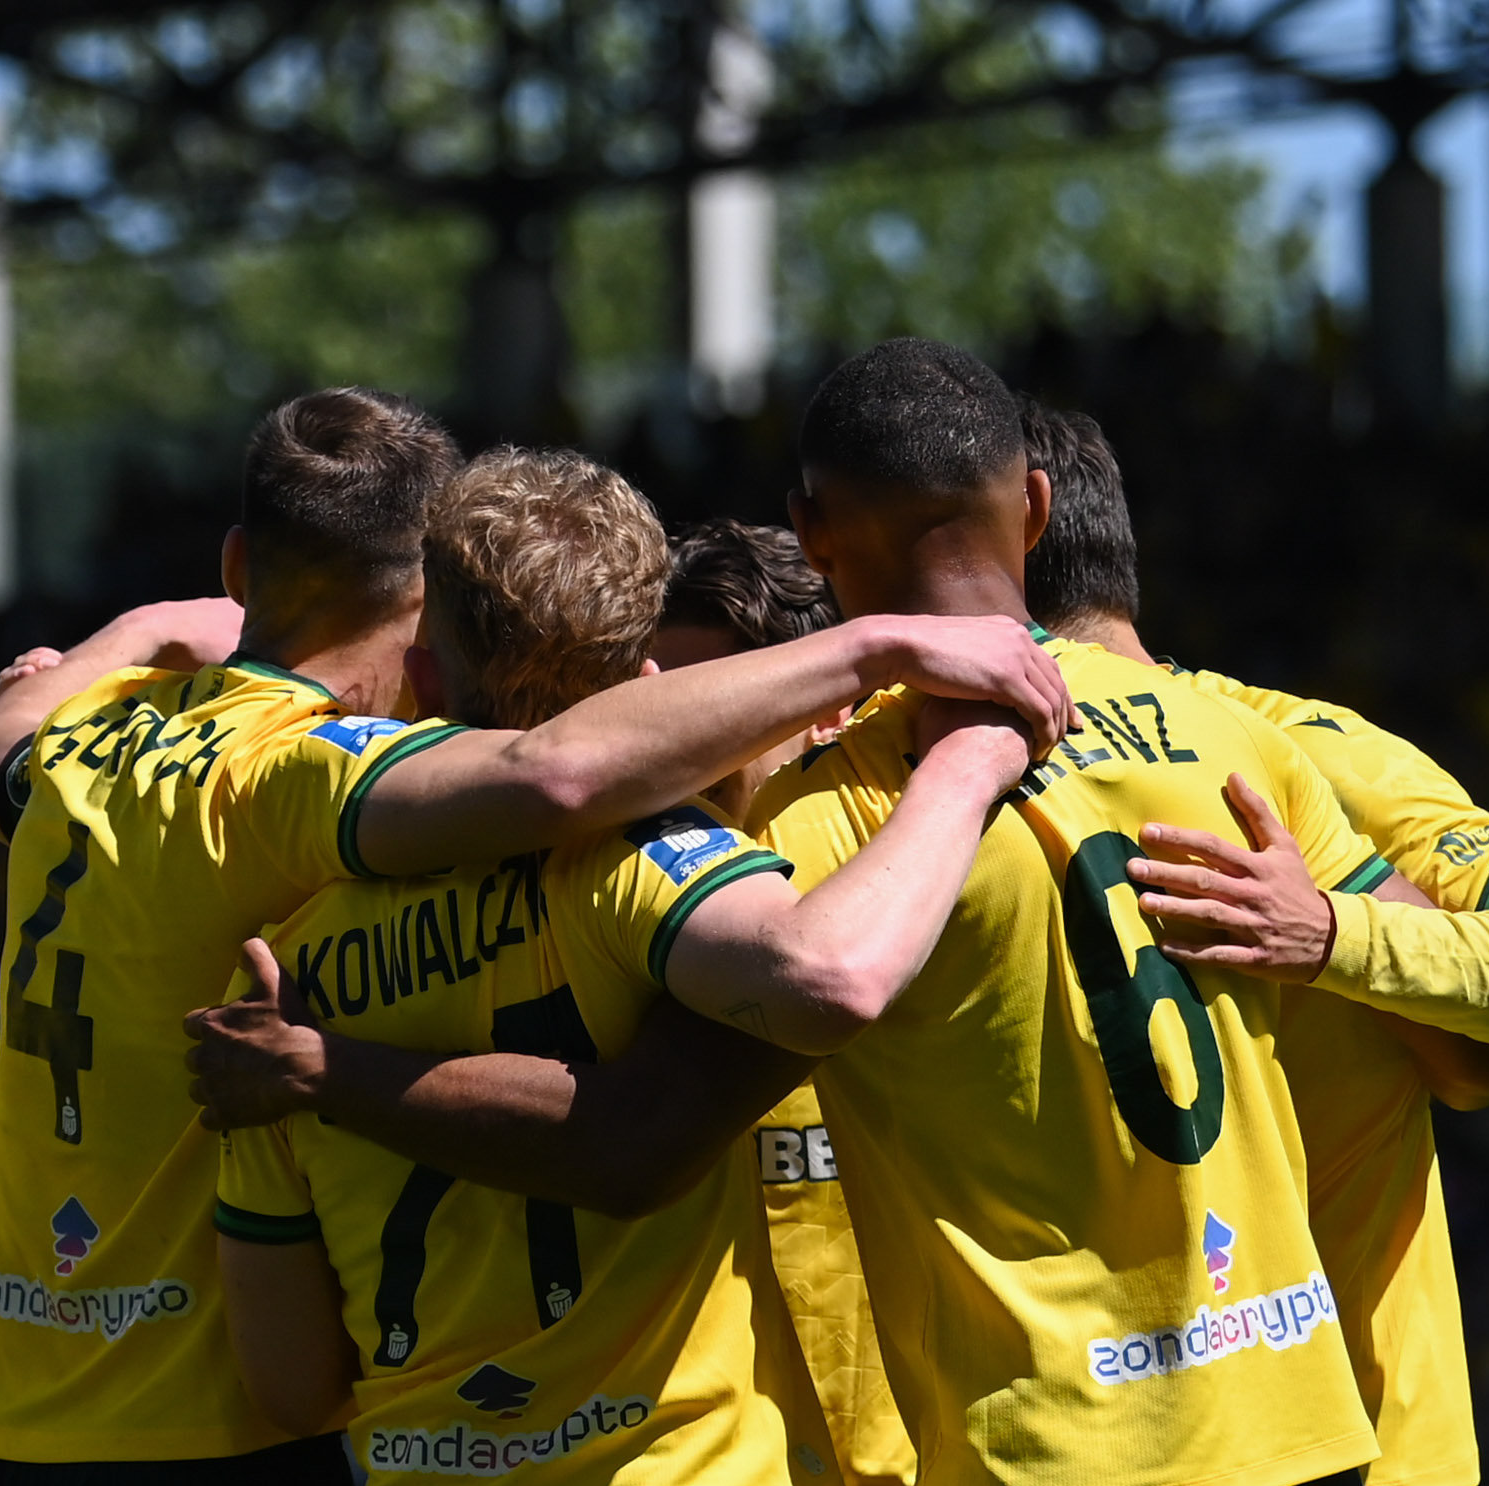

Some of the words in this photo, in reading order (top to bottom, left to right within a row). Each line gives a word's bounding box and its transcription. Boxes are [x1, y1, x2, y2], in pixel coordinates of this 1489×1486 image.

[7, 820, 93, 1145] 4
[1063, 831, 1225, 1165] 6
[1093, 1279, 1333, 1377] zondacrypt
